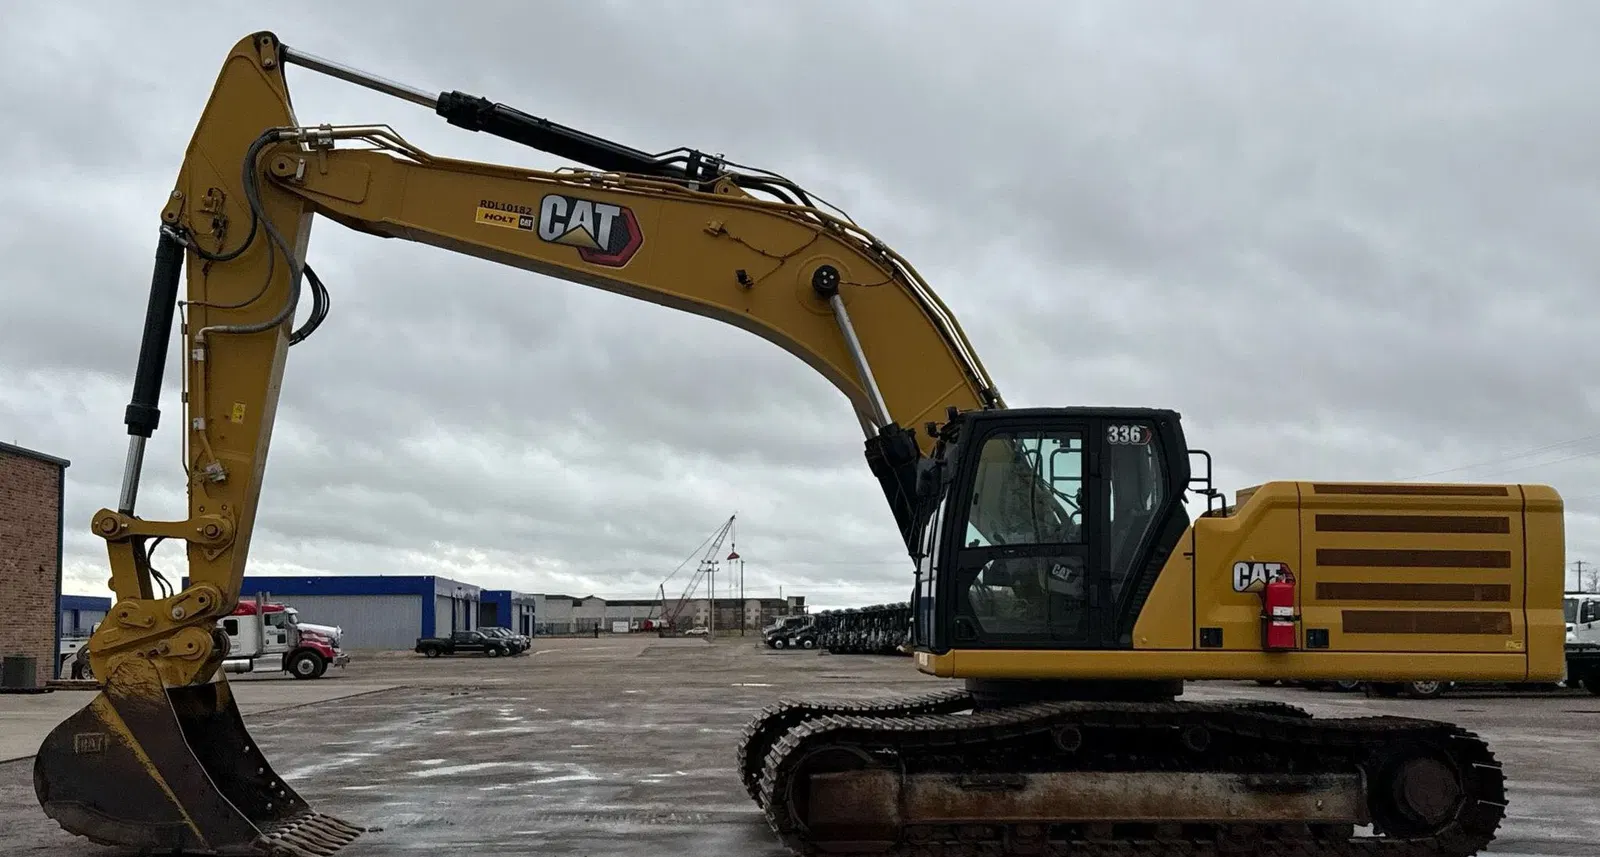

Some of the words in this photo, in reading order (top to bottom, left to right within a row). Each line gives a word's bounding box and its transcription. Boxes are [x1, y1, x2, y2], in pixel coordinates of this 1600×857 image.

[480, 199, 533, 215] RDL10182
[484, 213, 516, 223] HOLT
[520, 218, 533, 227] CAT
[539, 194, 621, 251] CAT
[1108, 425, 1141, 443] 336
[1052, 563, 1073, 580] CAT
